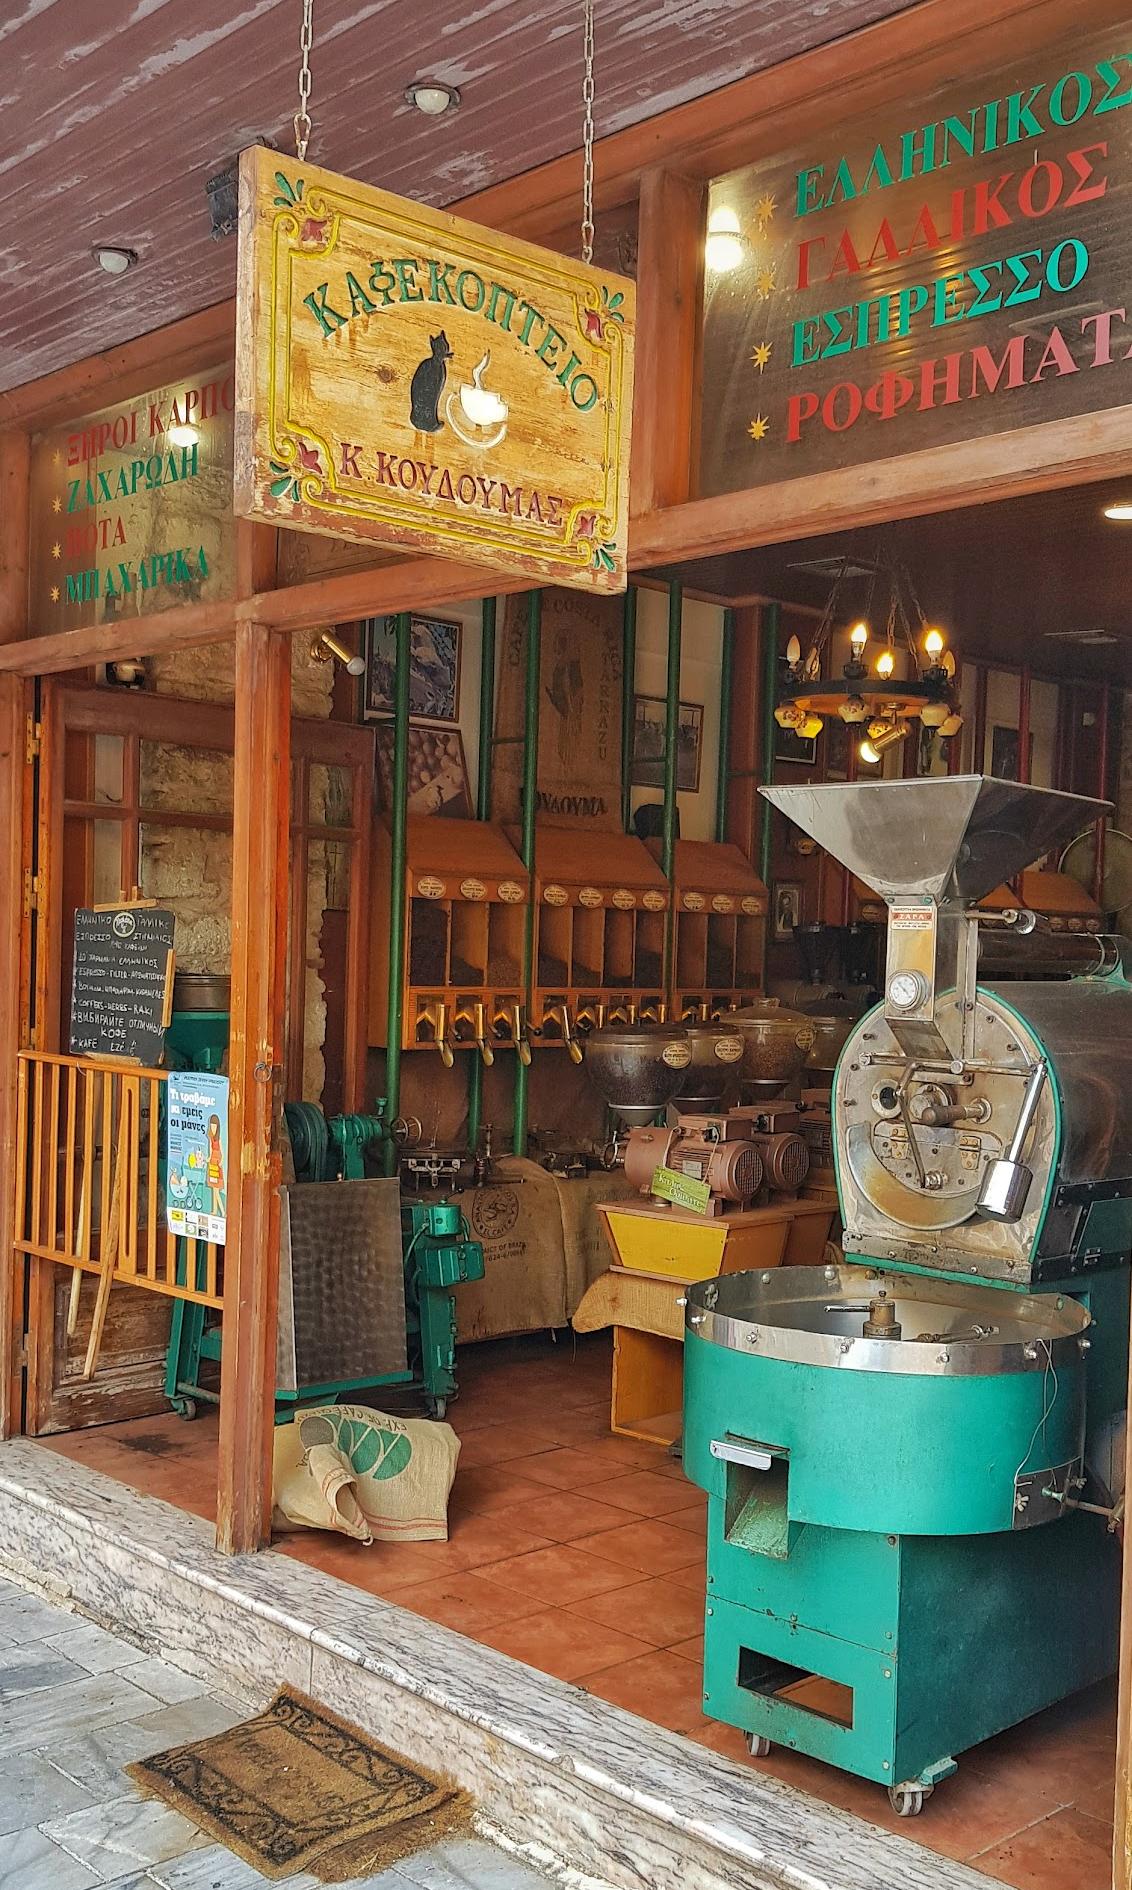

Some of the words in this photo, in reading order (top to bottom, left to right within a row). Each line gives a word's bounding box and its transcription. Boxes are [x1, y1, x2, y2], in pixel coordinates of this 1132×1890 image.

[793, 53, 1132, 218] ΕΛΛΗΝΙΚΟΣ
[795, 141, 1109, 292] ΓΑΛΛΙΚΟΣ
[303, 258, 599, 412] ΚΑΦΕΚΟΠΤΕΙΟ
[790, 238, 1090, 368] ΕΣΠΡΕΣΣΟ
[784, 308, 1132, 443] ΡΟΦΗΜΑΤ
[67, 411, 137, 467] ΞΗΡΟΙ
[67, 442, 199, 513] ΖΑΧΑΡΩΔΗ
[66, 545, 209, 605] ΜΠΑΧΑΡΙΚΑ
[170, 1118, 180, 1128] οι
[181, 1118, 206, 1135] μάνες
[182, 1106, 203, 1120] εμείς
